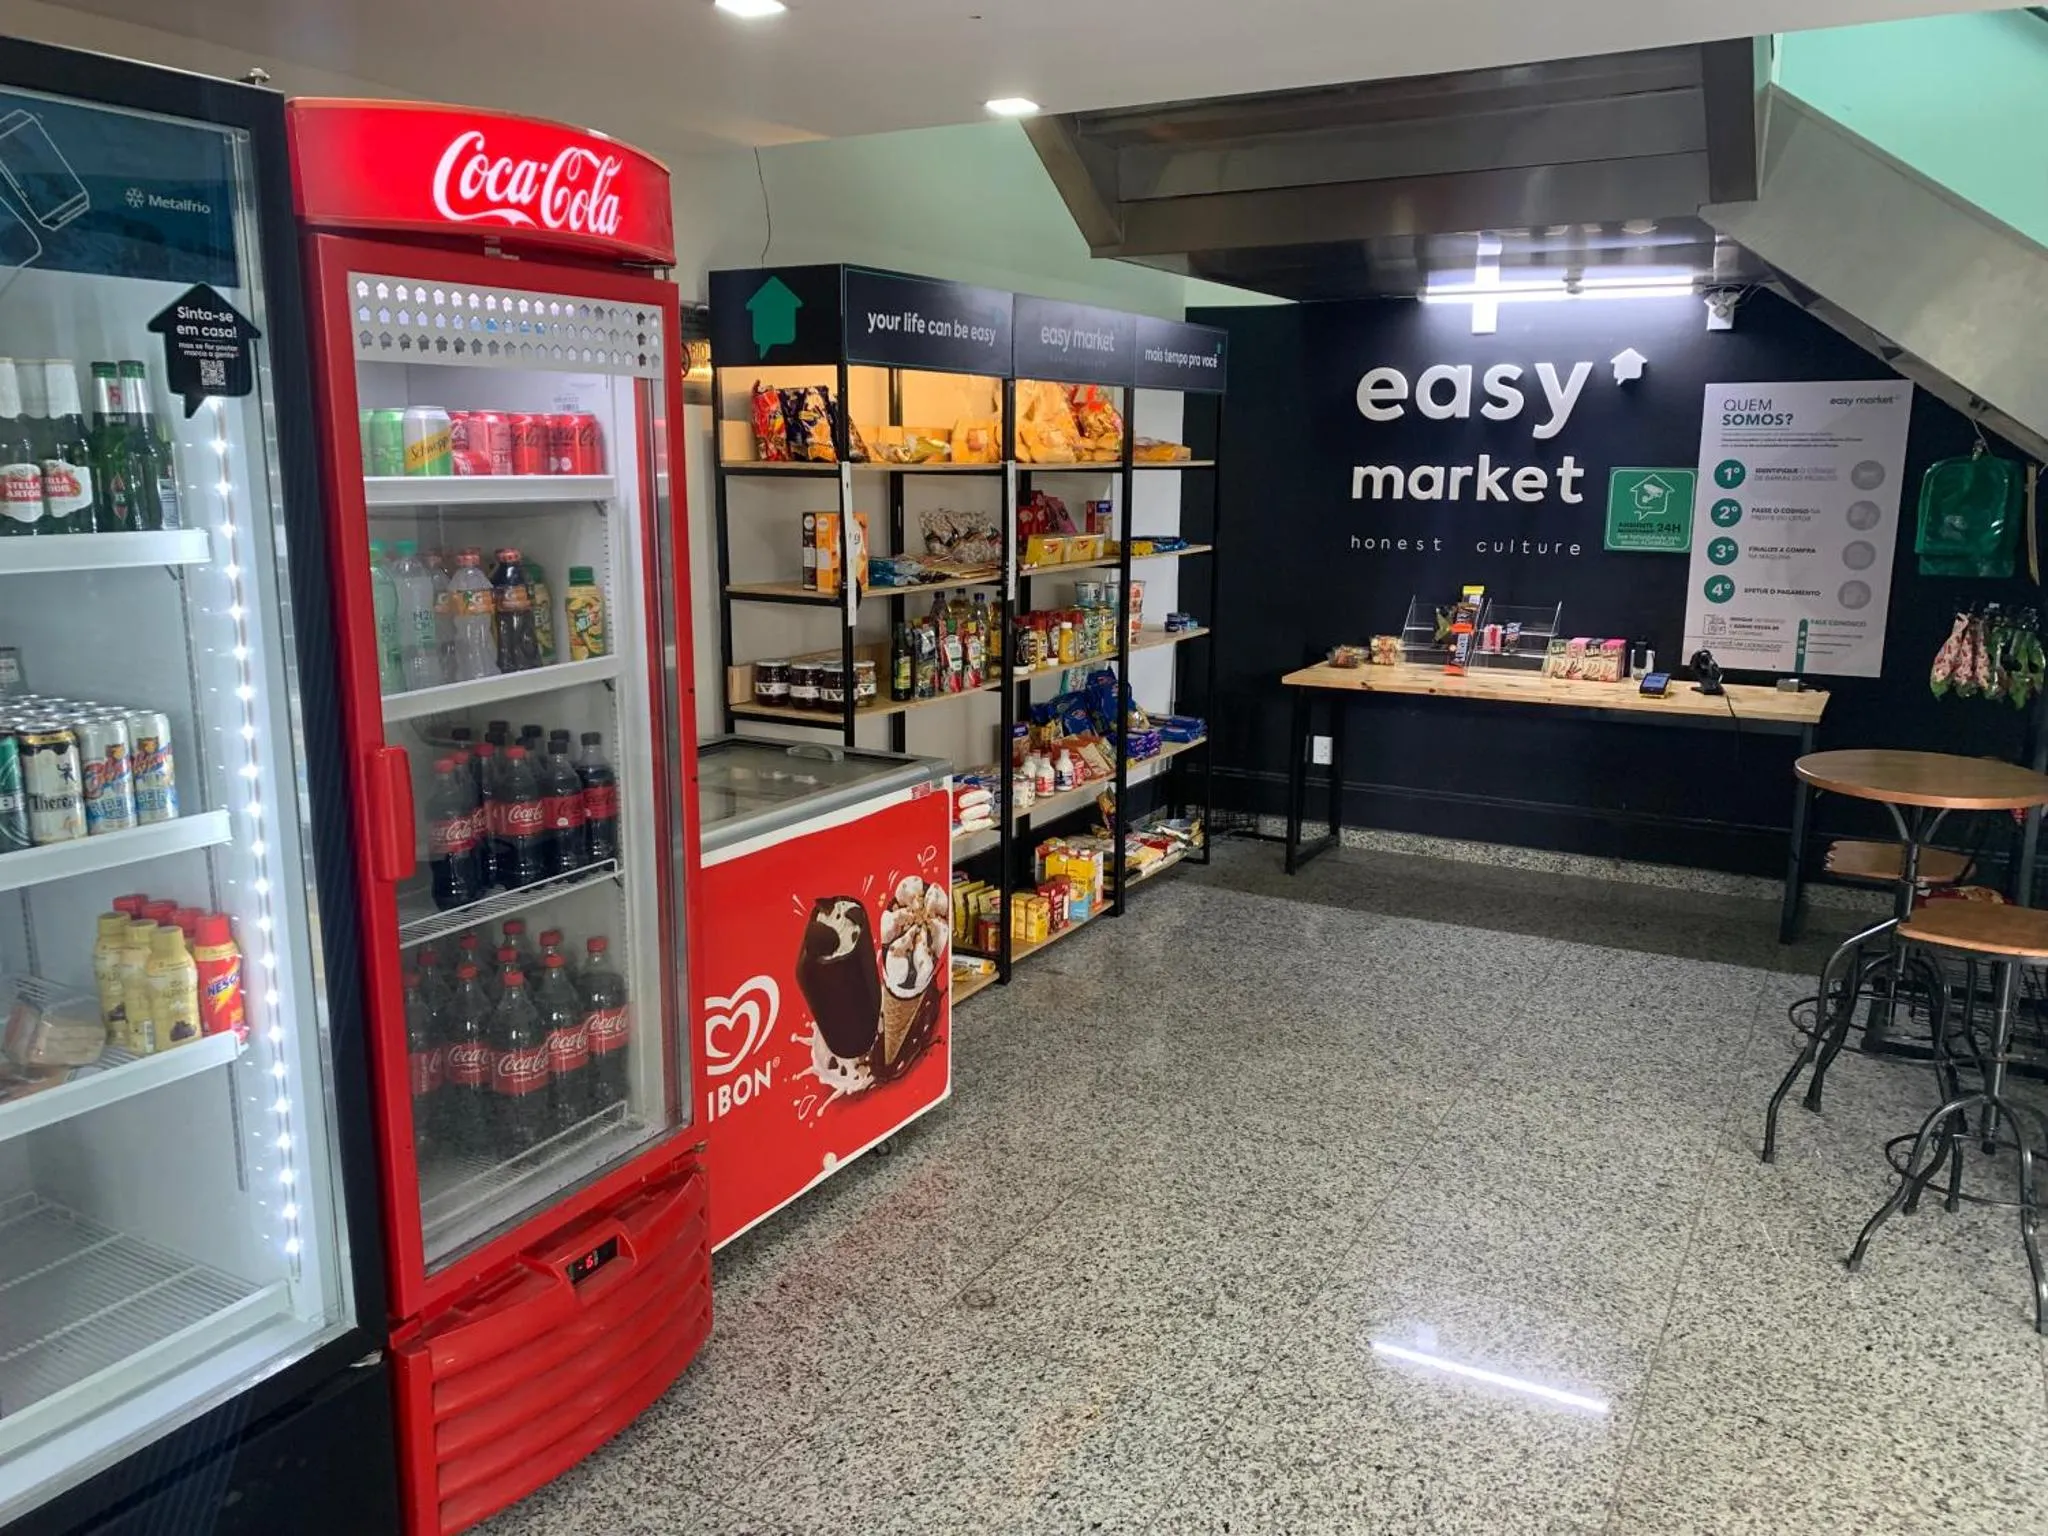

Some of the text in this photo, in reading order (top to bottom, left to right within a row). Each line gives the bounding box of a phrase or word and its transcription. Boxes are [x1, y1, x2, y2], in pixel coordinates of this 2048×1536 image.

[433, 131, 623, 236] Coca-Cola
[148, 194, 211, 214] Metalfrio
[176, 305, 234, 322] Sinta-se
[176, 323, 238, 339] em casa!
[867, 310, 997, 347] your life can be easy
[1040, 324, 1115, 353] easy market
[1145, 347, 1218, 370] mais tempo pra você
[1356, 362, 1594, 439] easy
[1723, 398, 1773, 412] QUEM
[1829, 395, 1894, 407] easy market
[1721, 413, 1794, 426] SOMOS?
[1352, 454, 1585, 504] market
[1656, 523, 1681, 533] 24H
[1350, 535, 1581, 556] honest culture
[707, 1061, 773, 1123] IBON
